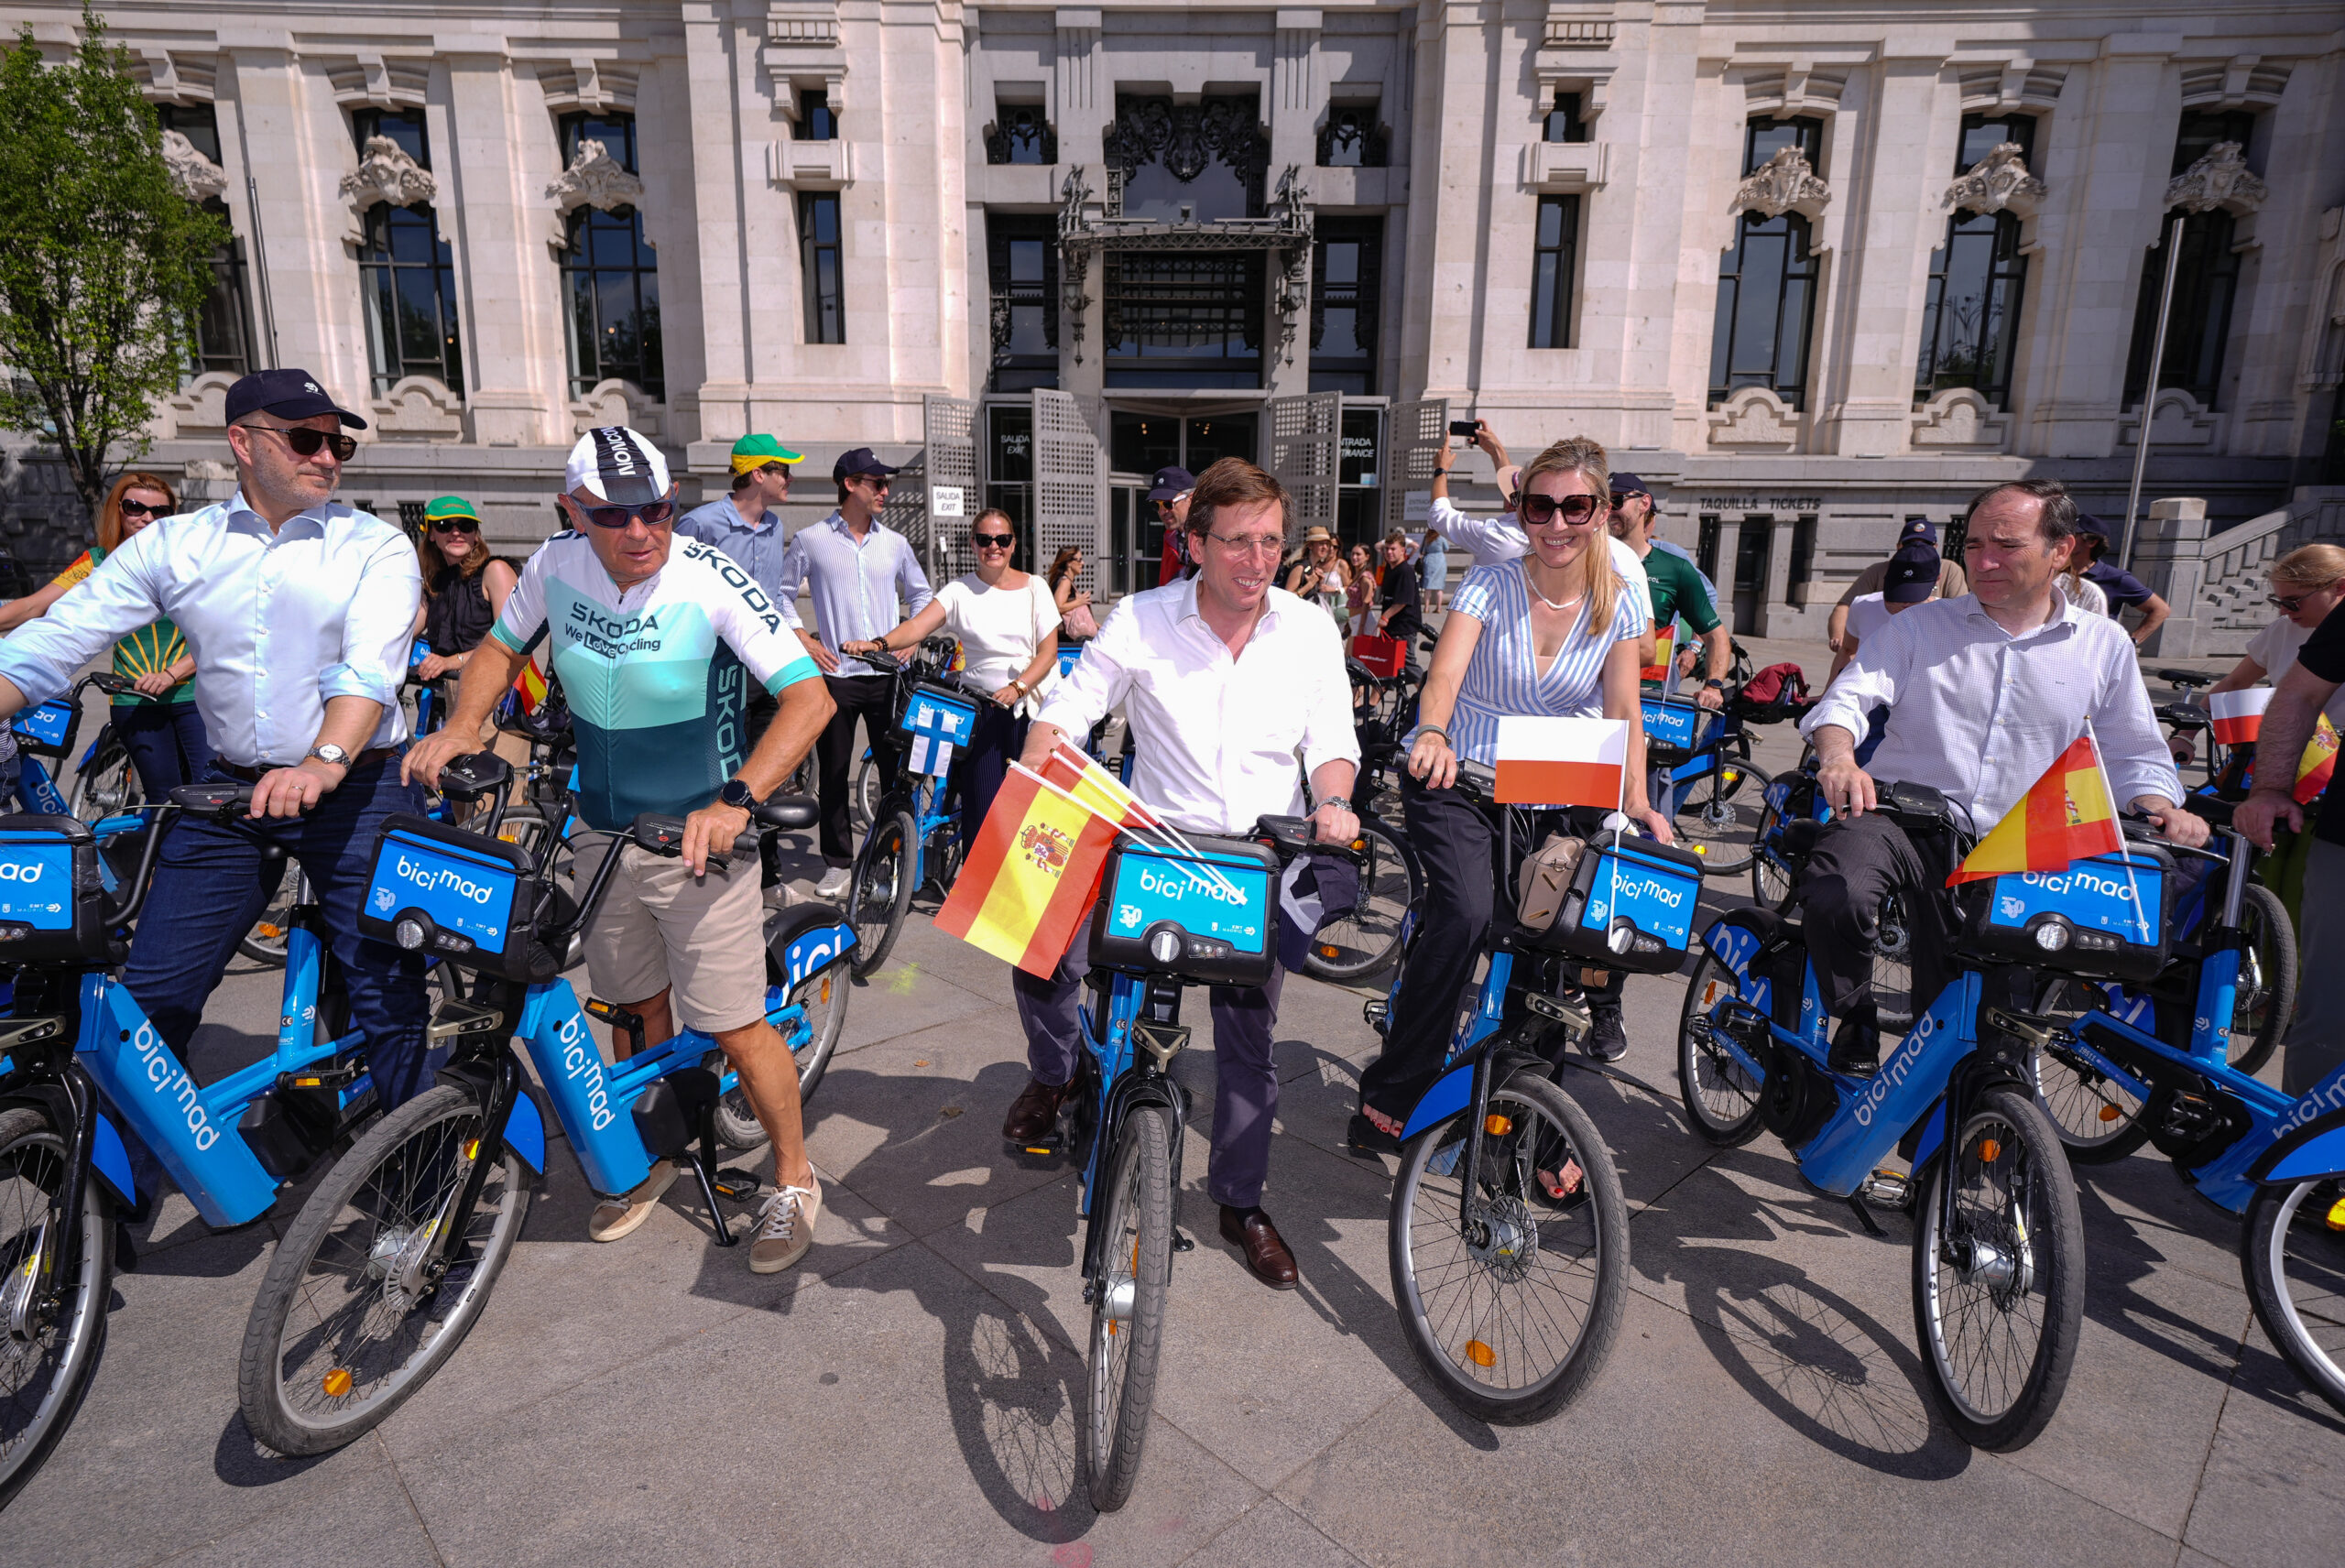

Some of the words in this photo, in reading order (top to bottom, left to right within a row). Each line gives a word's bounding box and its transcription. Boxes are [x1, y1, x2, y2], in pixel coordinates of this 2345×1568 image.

[1001, 435, 1031, 443] SALIDA
[1007, 446, 1024, 454] EXIT
[1341, 449, 1375, 458] TRANCE
[936, 492, 960, 500] SALIDA
[942, 503, 956, 511] EXIT
[1700, 498, 1758, 509] TAQUILLA
[1769, 498, 1821, 510] TICKETS
[565, 623, 584, 642] We
[586, 634, 616, 658] Love
[716, 665, 743, 783] SKOD
[1642, 711, 1685, 727] icimad
[397, 855, 493, 904] bicimad
[1140, 869, 1246, 905] bicimad
[560, 1011, 616, 1131] bicimad
[1853, 1010, 1934, 1127] bicimad
[135, 1019, 220, 1151] bicimad
